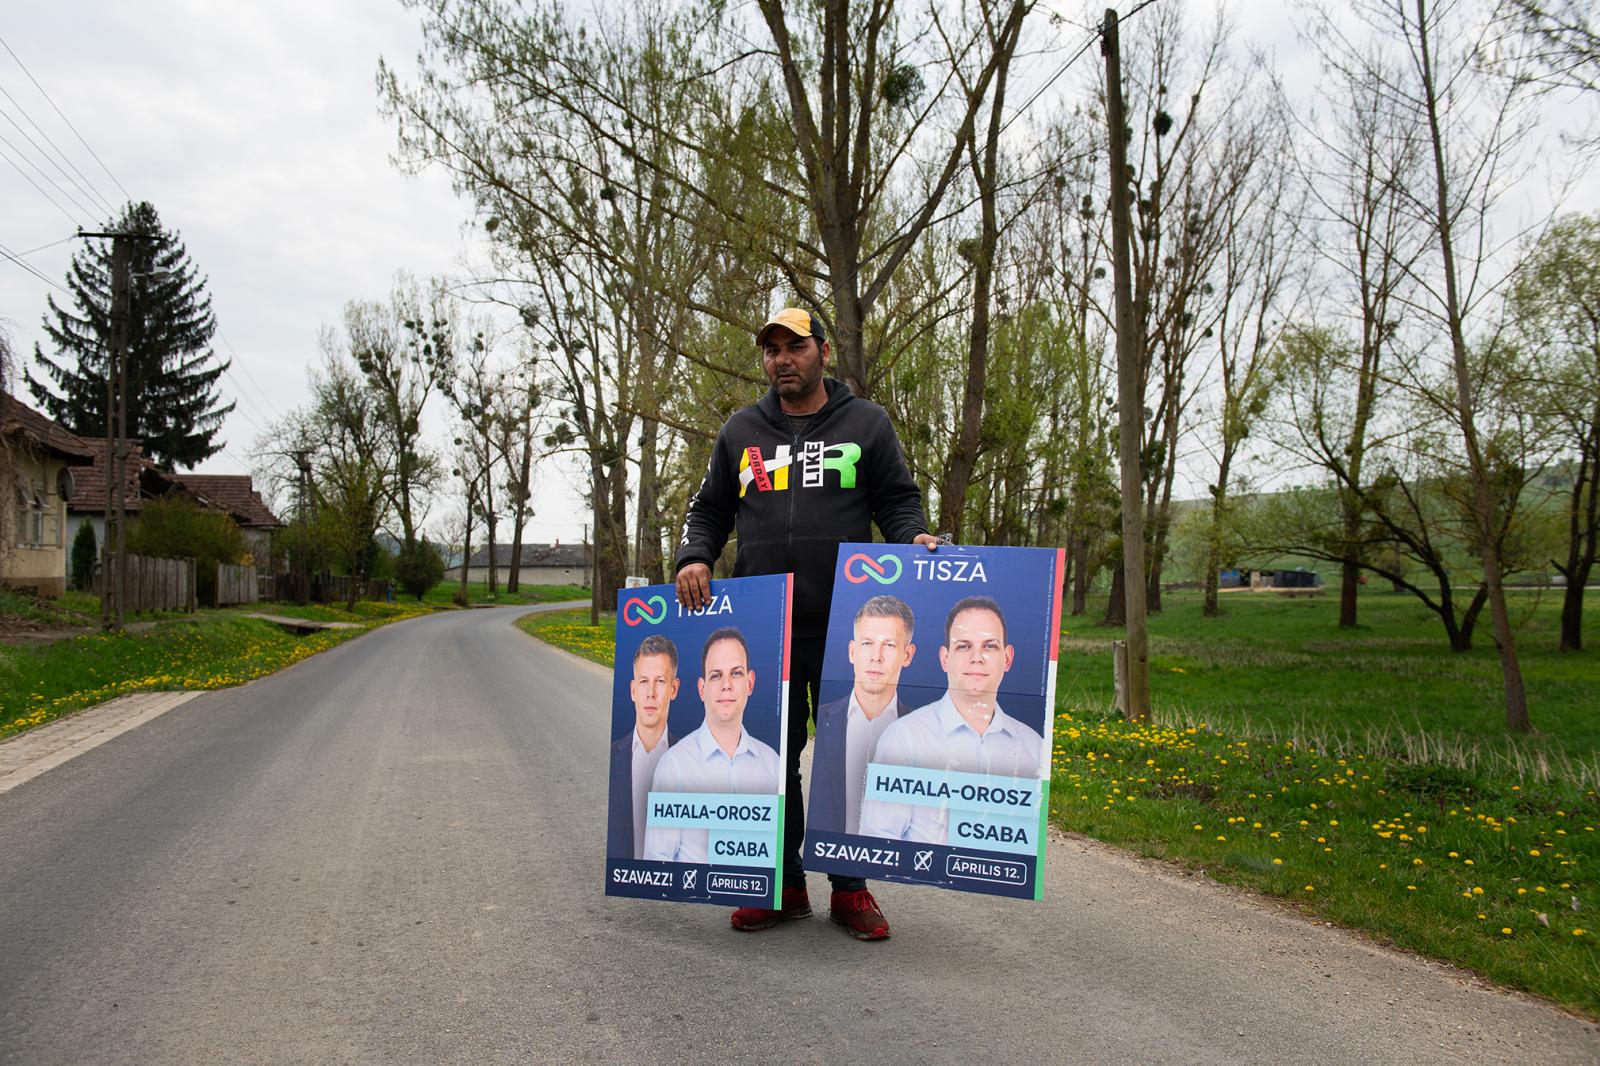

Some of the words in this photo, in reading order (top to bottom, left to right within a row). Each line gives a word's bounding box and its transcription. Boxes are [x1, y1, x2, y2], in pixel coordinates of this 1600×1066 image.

[805, 443, 821, 485] LIKE
[913, 560, 988, 583] TISZA
[675, 594, 734, 618] TZA
[876, 776, 1033, 807] HATALA-OROSZ
[654, 803, 771, 822] HATALA-OROSZ
[957, 821, 1029, 845] CSABA
[714, 840, 769, 858] CSABA
[814, 842, 900, 867] SZAVAZZ!
[613, 868, 673, 887] SZAVAZZ!
[952, 860, 1002, 878] ÁPRILIS
[1003, 867, 1021, 880] 12.
[711, 874, 749, 891] ÁPRILIS
[750, 880, 763, 892] 12.
